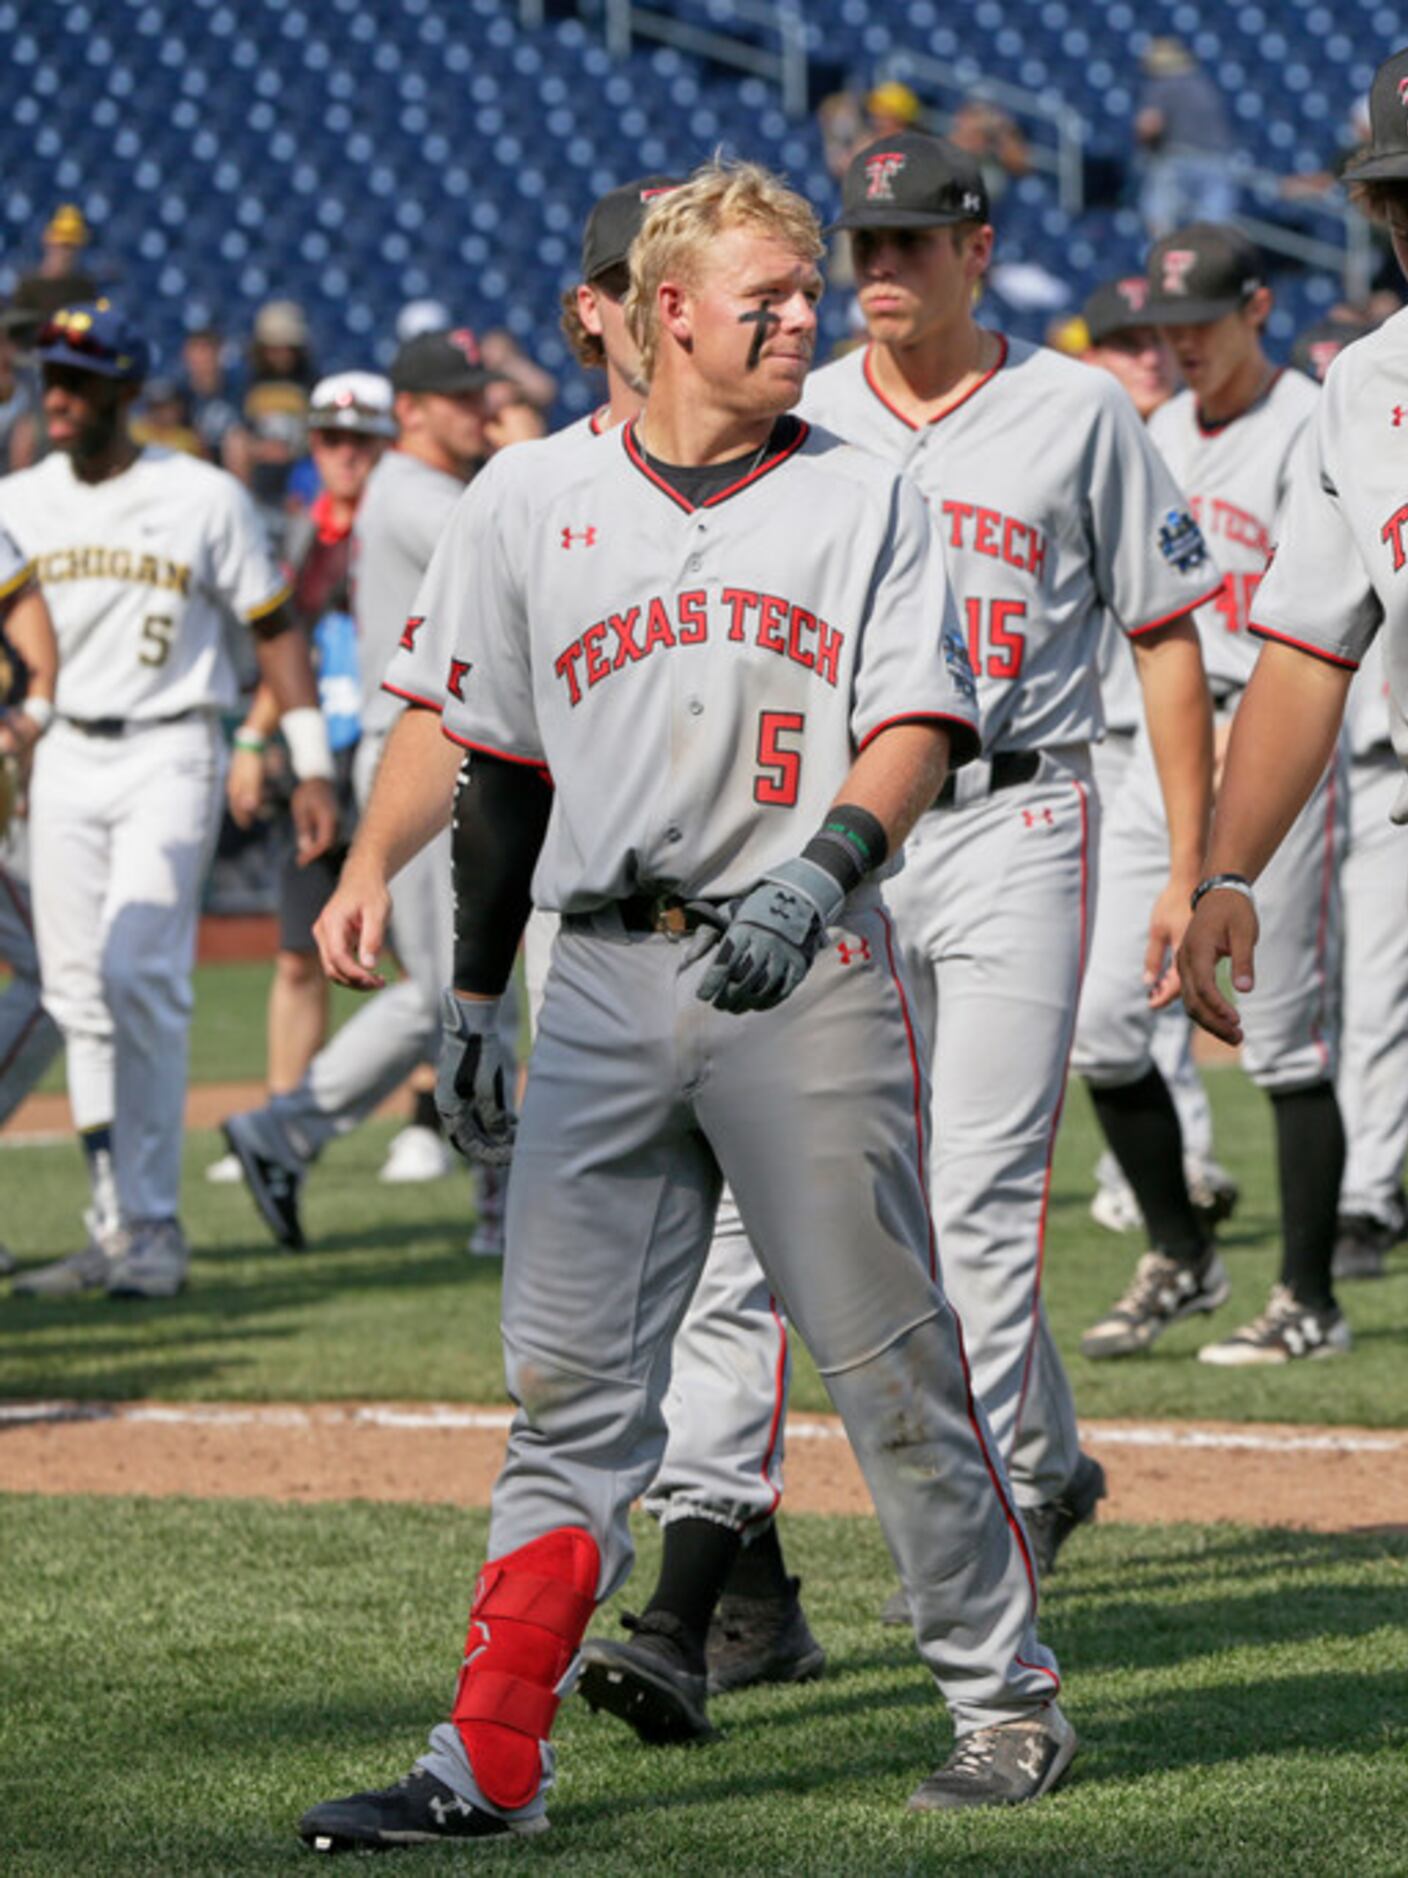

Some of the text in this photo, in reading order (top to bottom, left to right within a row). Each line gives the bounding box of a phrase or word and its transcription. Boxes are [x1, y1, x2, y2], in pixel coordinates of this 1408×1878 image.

[942, 498, 1048, 576] TECH
[139, 613, 173, 668] 5
[554, 586, 845, 707] TEXAS TECH
[964, 597, 1027, 679] 15
[753, 710, 806, 808] 5
